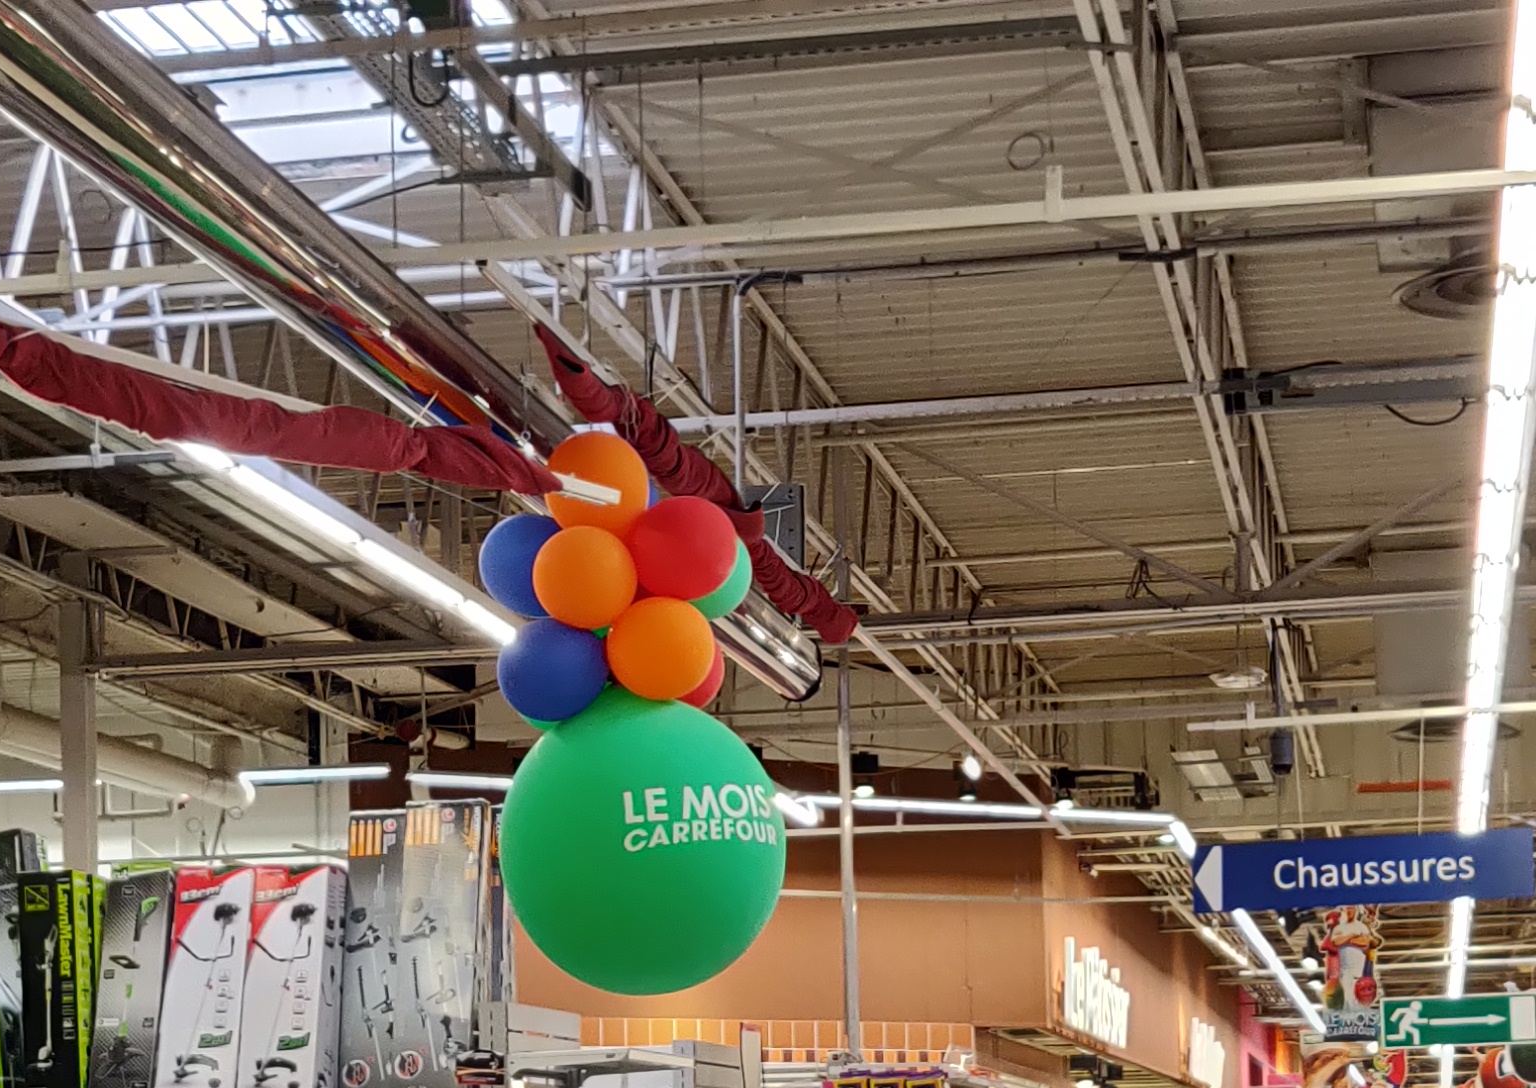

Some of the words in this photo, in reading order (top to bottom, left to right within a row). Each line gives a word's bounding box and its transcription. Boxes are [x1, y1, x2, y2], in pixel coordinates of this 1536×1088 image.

[622, 786, 669, 825] LE
[682, 783, 772, 821] MOIS
[622, 817, 778, 853] CARREFOUR
[1273, 853, 1476, 891] Chaussures
